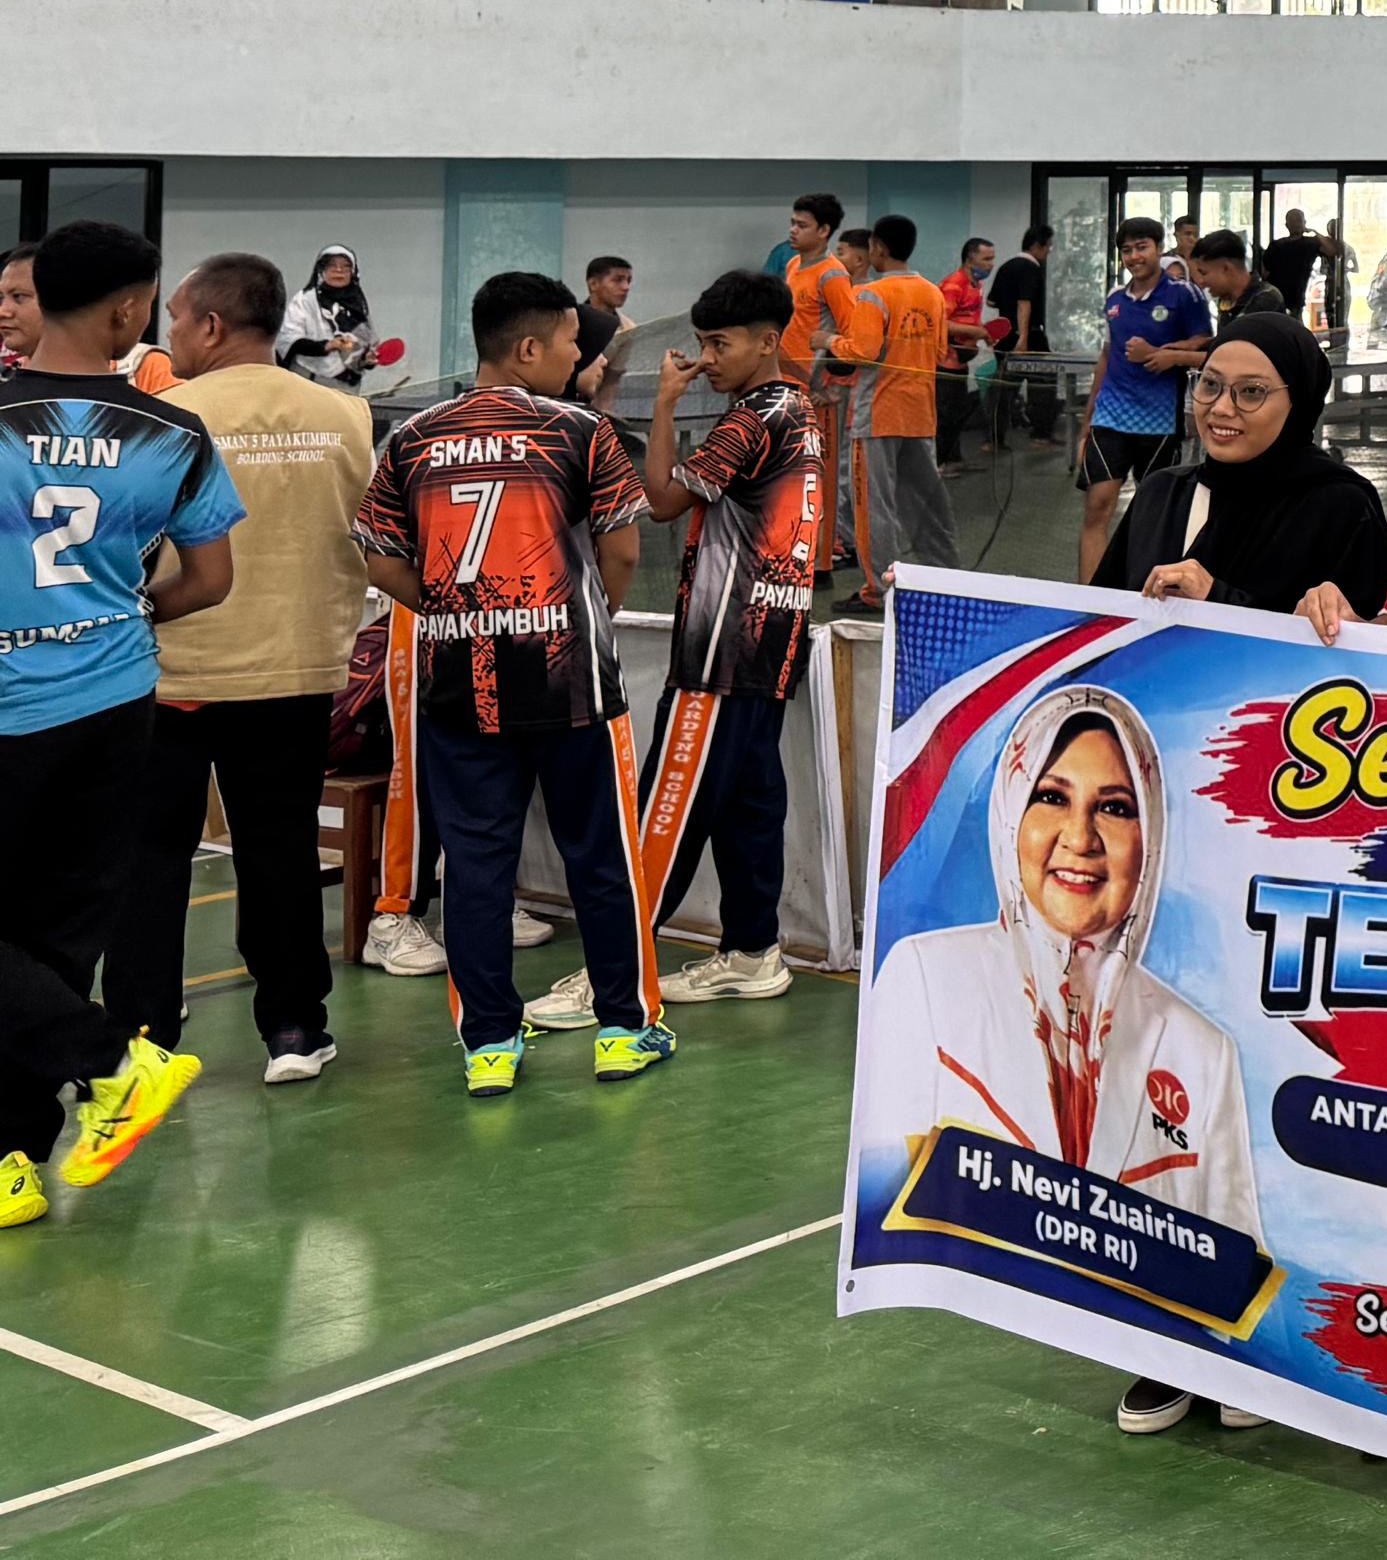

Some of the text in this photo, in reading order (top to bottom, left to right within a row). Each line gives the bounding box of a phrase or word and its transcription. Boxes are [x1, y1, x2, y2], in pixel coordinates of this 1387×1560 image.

[26, 434, 121, 468] TIAN
[214, 432, 342, 450] SMAN 5 PAYAKUMBUH
[236, 450, 326, 465] BOARDING SCHOOL
[430, 435, 528, 468] SMAN 5
[32, 485, 101, 589] 2
[450, 481, 506, 584] 7
[418, 604, 568, 641] PAYAKUMBUH
[652, 691, 707, 836] OARDING SCHOOL
[1151, 1112, 1189, 1151] PKS
[957, 1145, 1217, 1261] Hj. Nevi Zuairina
[1035, 1211, 1139, 1272] (DPR RI)
